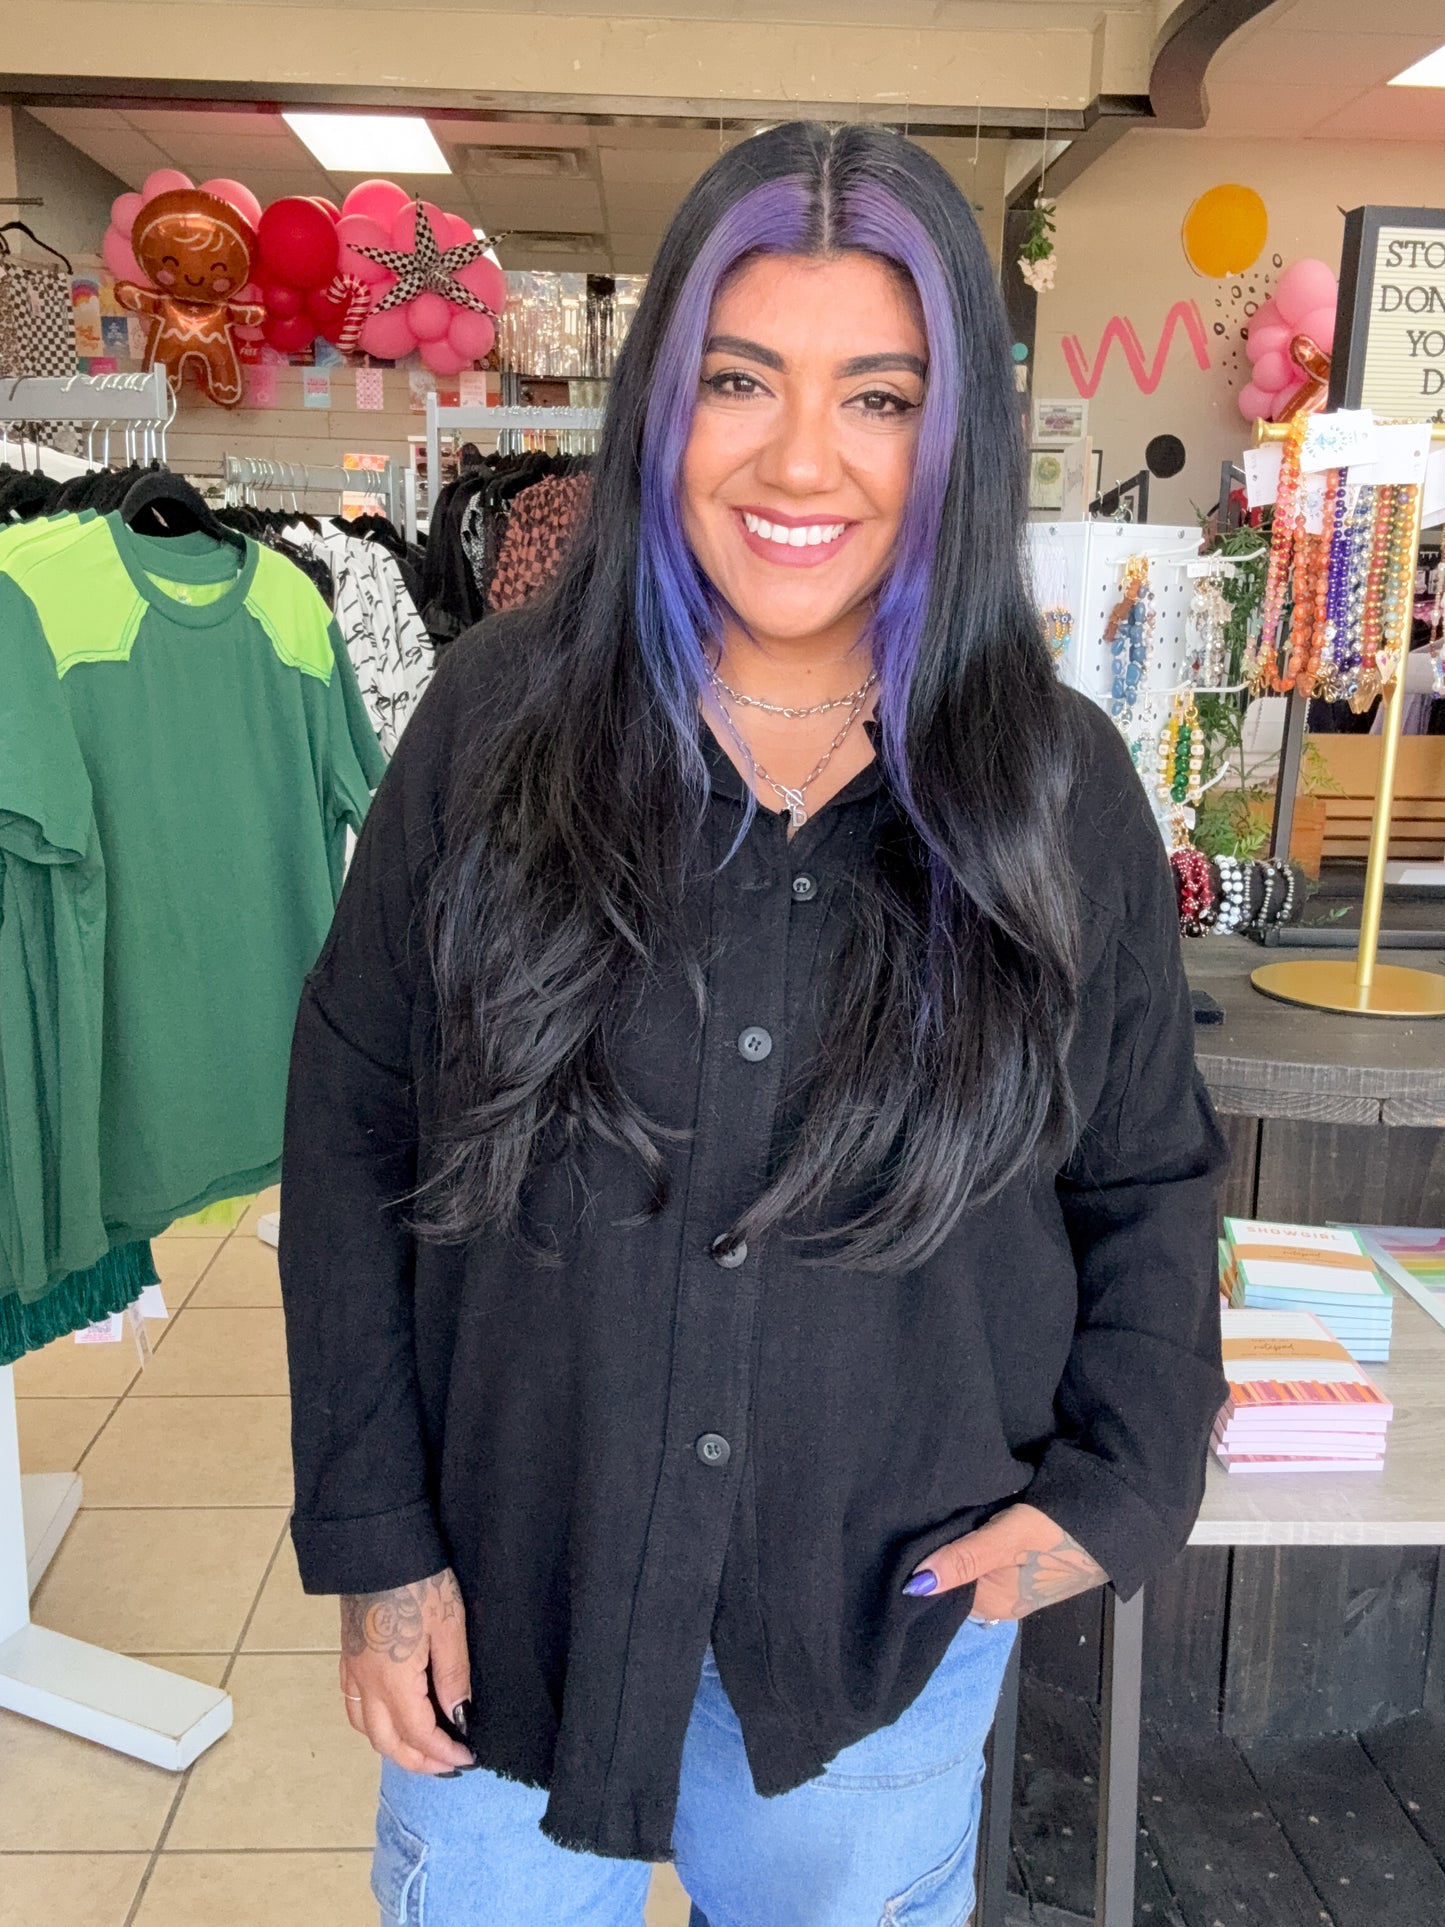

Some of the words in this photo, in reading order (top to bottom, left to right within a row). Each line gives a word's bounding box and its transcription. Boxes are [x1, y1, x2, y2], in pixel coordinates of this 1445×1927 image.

[1386, 240, 1445, 269] STO
[1406, 330, 1445, 357] YO
[1421, 369, 1445, 395] D
[1246, 1226, 1341, 1241] SHOWGIRL
[1253, 1343, 1295, 1352] notepad
